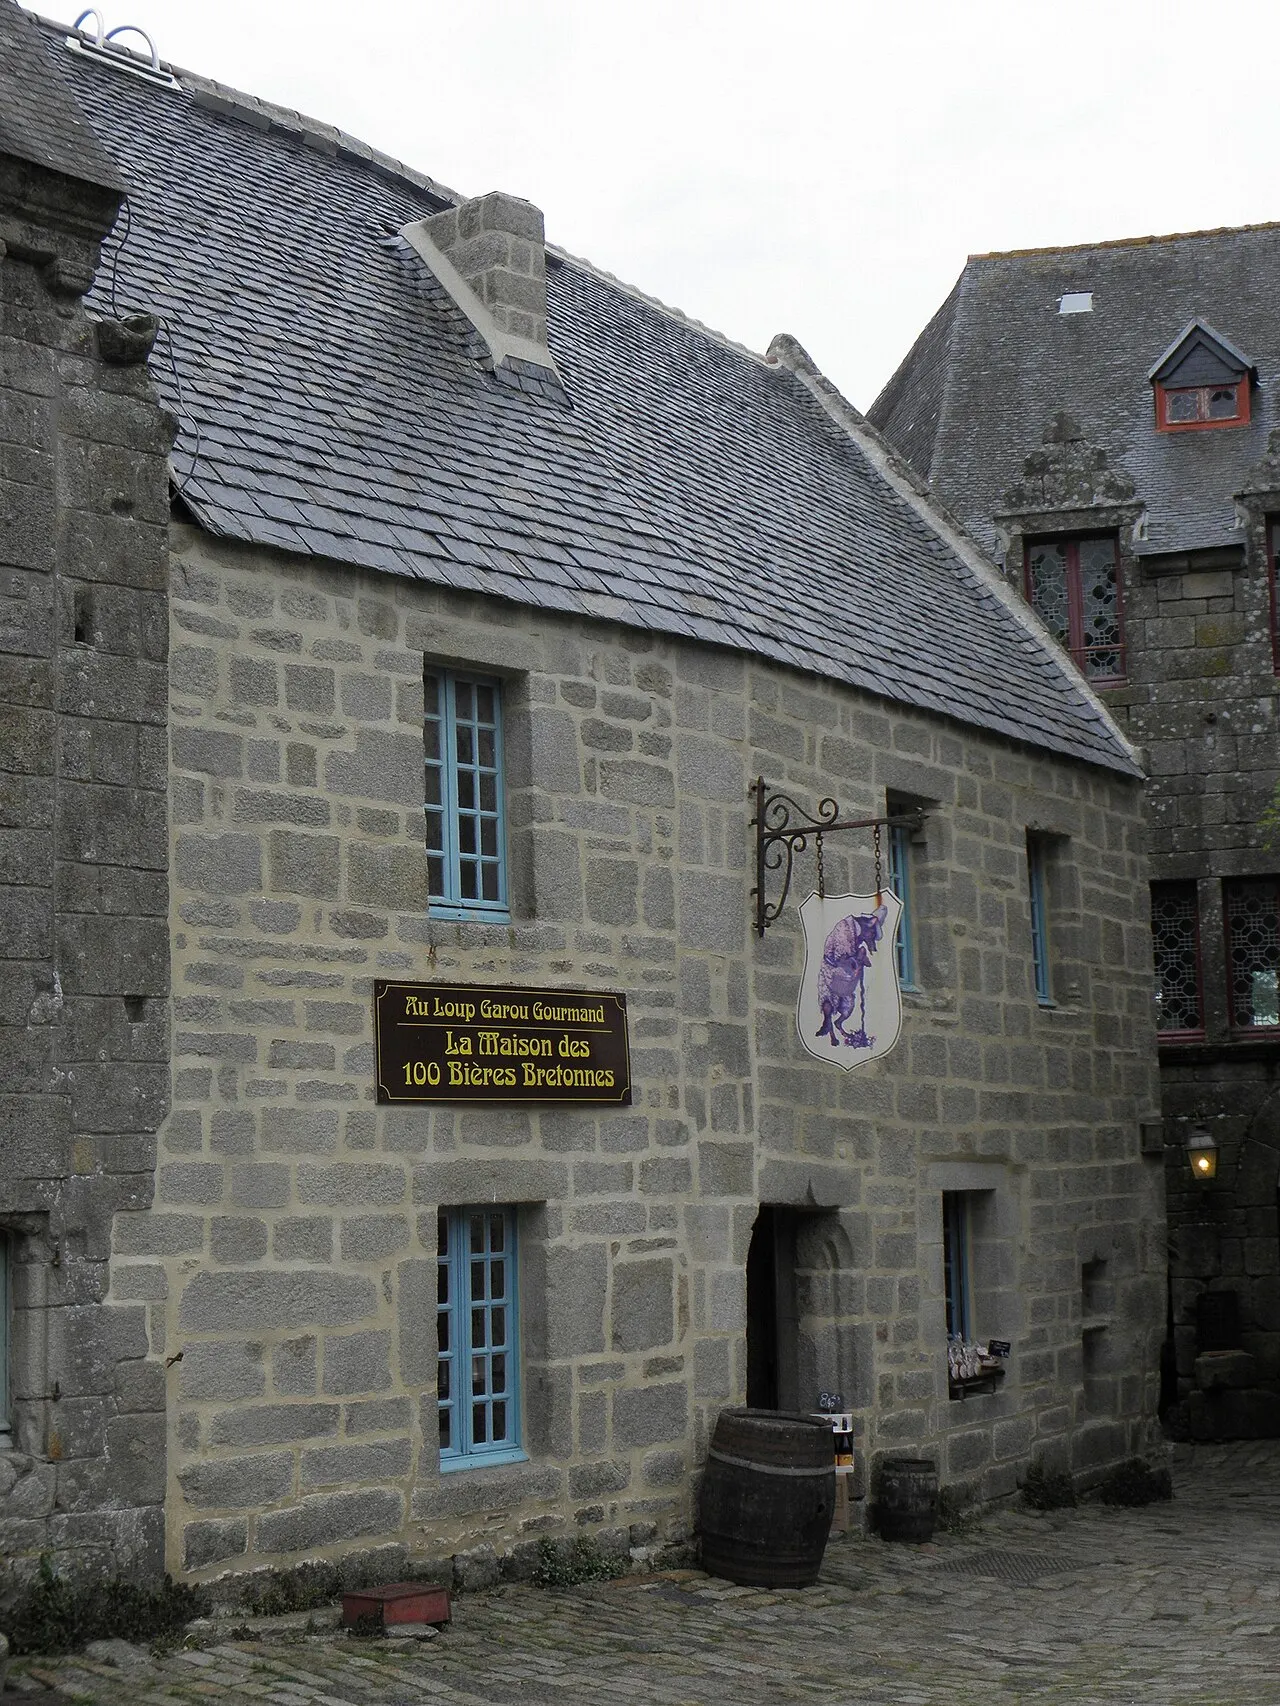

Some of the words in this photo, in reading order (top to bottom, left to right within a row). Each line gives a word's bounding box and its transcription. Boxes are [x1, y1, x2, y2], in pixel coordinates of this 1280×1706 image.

[405, 996, 429, 1016] Au
[433, 997, 476, 1022] Loup
[480, 1000, 529, 1020] Garou
[532, 1001, 605, 1023] Gourmand
[444, 1031, 473, 1055] La
[477, 1031, 553, 1056] Maison
[558, 1034, 590, 1058] des
[402, 1061, 441, 1085] 100
[447, 1061, 516, 1086] Bières
[521, 1062, 615, 1087] Bretonnes
